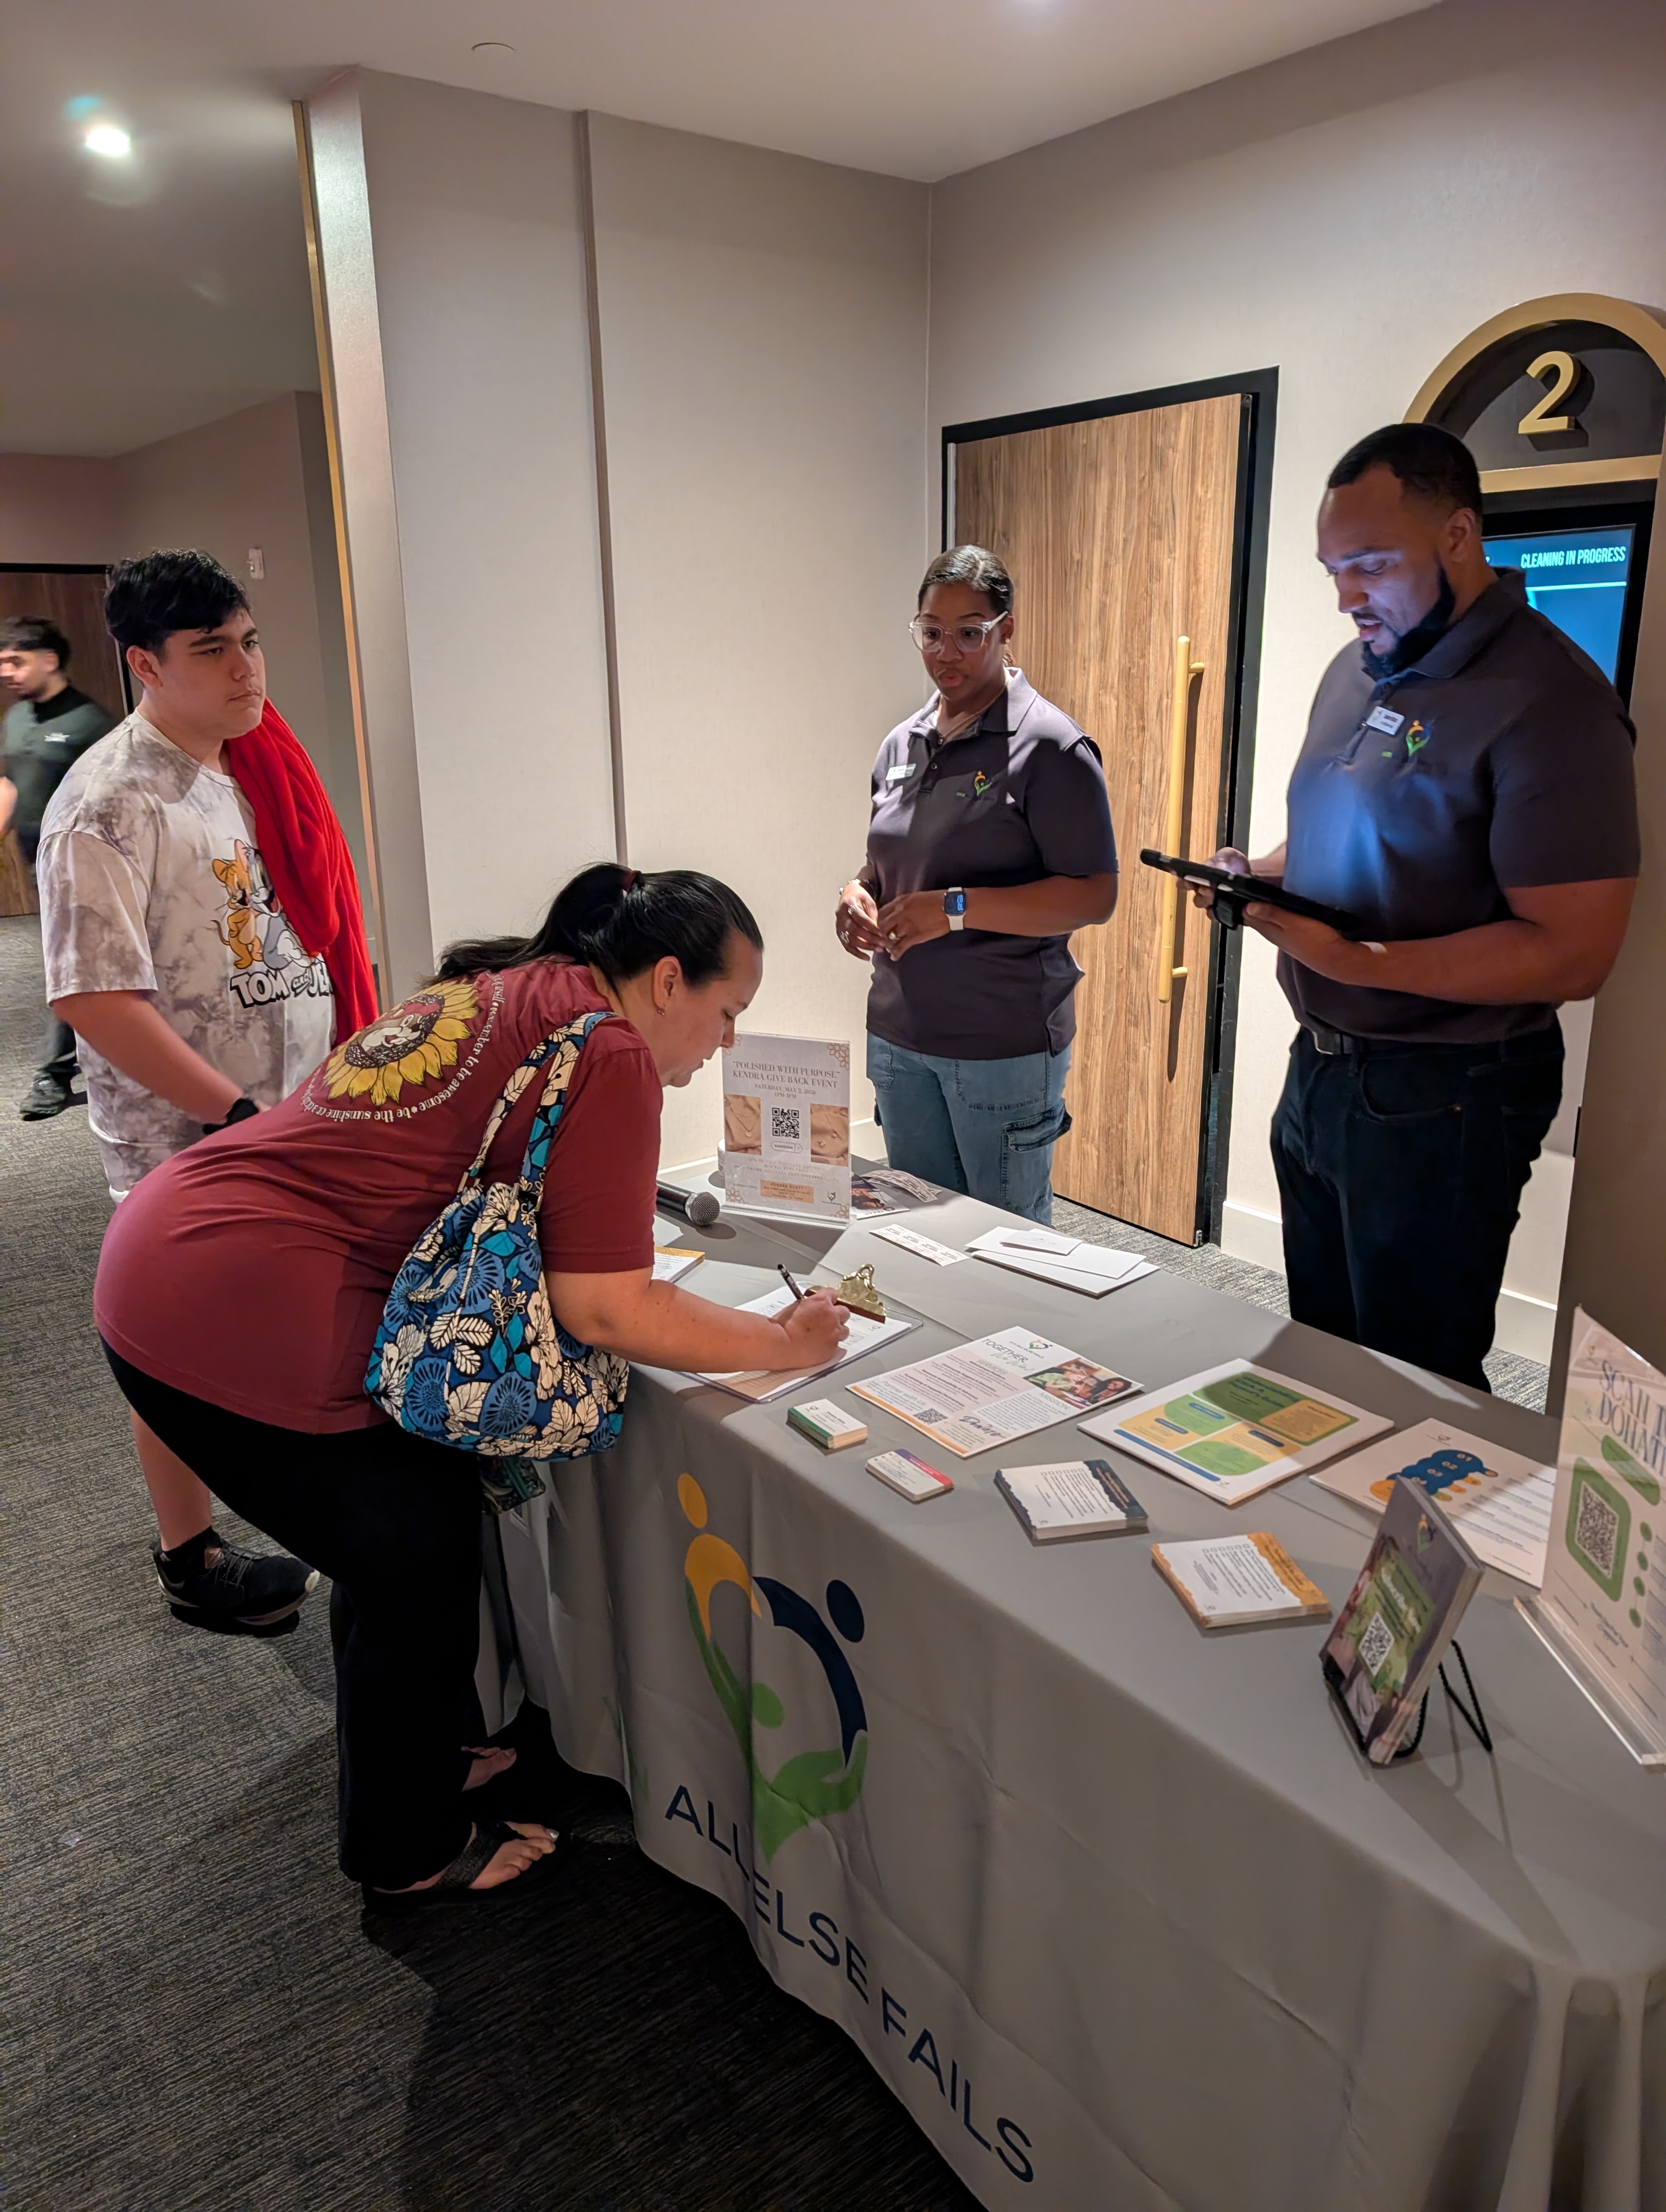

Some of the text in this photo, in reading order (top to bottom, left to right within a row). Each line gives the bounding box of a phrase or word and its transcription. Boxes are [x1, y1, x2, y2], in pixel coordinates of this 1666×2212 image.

[1518, 350, 1578, 434] 2
[1520, 546, 1626, 569] CLEANING IN PROGRESS
[230, 962, 333, 1008] TOM and JE
[465, 1056, 479, 1068] to
[777, 1065, 799, 1074] WITH
[456, 1066, 473, 1081] be
[733, 1070, 838, 1088] KENDRA GIVE BACK EVENT
[419, 1078, 460, 1111] awesome
[326, 1108, 371, 1122] sunshine
[375, 1109, 394, 1123] the
[396, 1108, 412, 1120] be
[982, 1339, 1028, 1363] TOGETHER
[976, 1359, 1008, 1375] SERVICES
[882, 1380, 904, 1393] Partner
[903, 1392, 917, 1401] with
[1599, 1360, 1650, 1425] SCAN
[1039, 1392, 1071, 1410] MISSION
[1441, 1461, 1458, 1470] 02
[1457, 1453, 1472, 1462] 01
[1427, 1469, 1443, 1477] 03
[664, 1785, 1034, 2183] ALL ELSE FAILS
